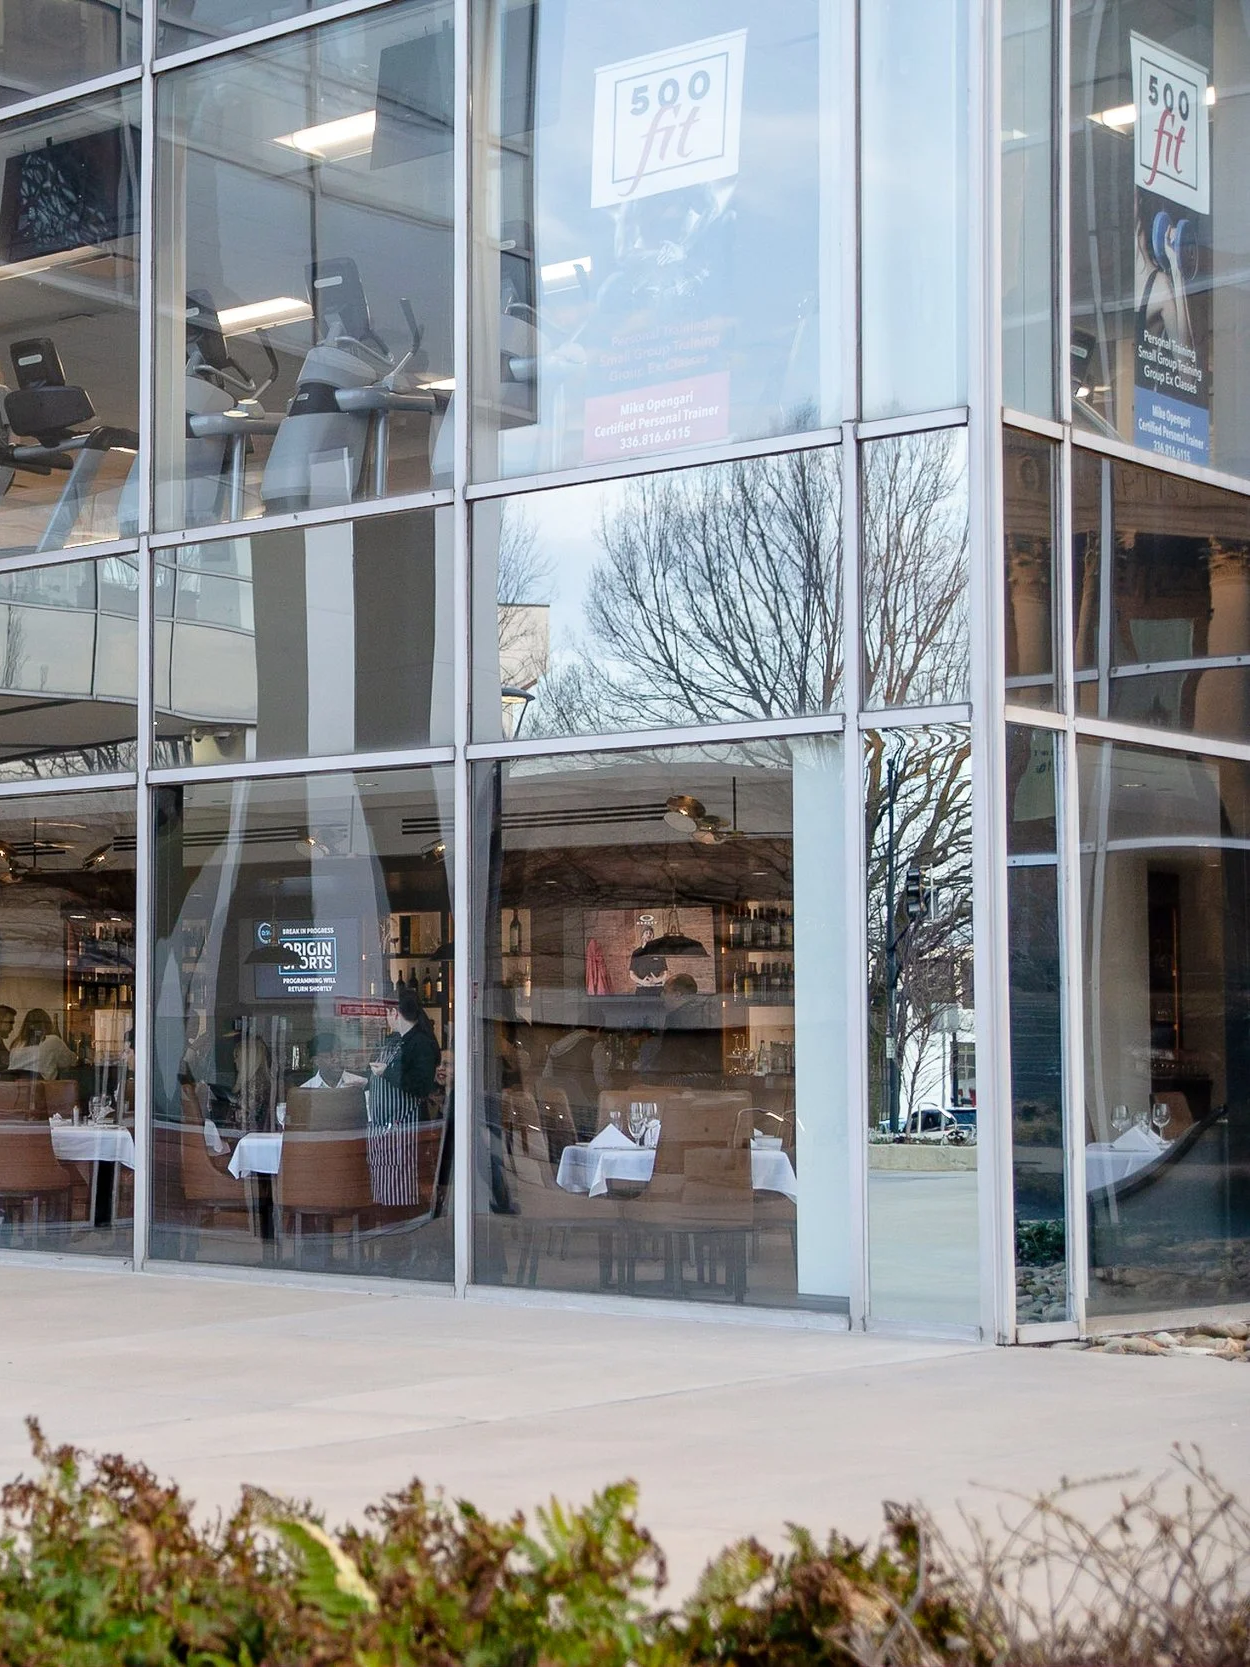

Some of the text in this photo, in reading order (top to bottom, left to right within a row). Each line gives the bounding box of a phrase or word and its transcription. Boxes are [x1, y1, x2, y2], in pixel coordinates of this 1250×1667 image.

[630, 70, 711, 116] 500
[1148, 75, 1189, 121] 500
[618, 103, 701, 197] fit
[1143, 109, 1186, 186] fit
[1143, 330, 1196, 363] Personal Training
[1138, 345, 1202, 382] Small Group Training
[1143, 365, 1197, 394] Group Ex Classes
[620, 391, 693, 416] Mike Opengari
[1152, 405, 1166, 420] Mike
[594, 405, 719, 437] Certified Personal Trainer
[1138, 418, 1204, 449] Certified Personal Trainer
[620, 426, 691, 449] 336.816.6115
[283, 956, 332, 970] ORTS
